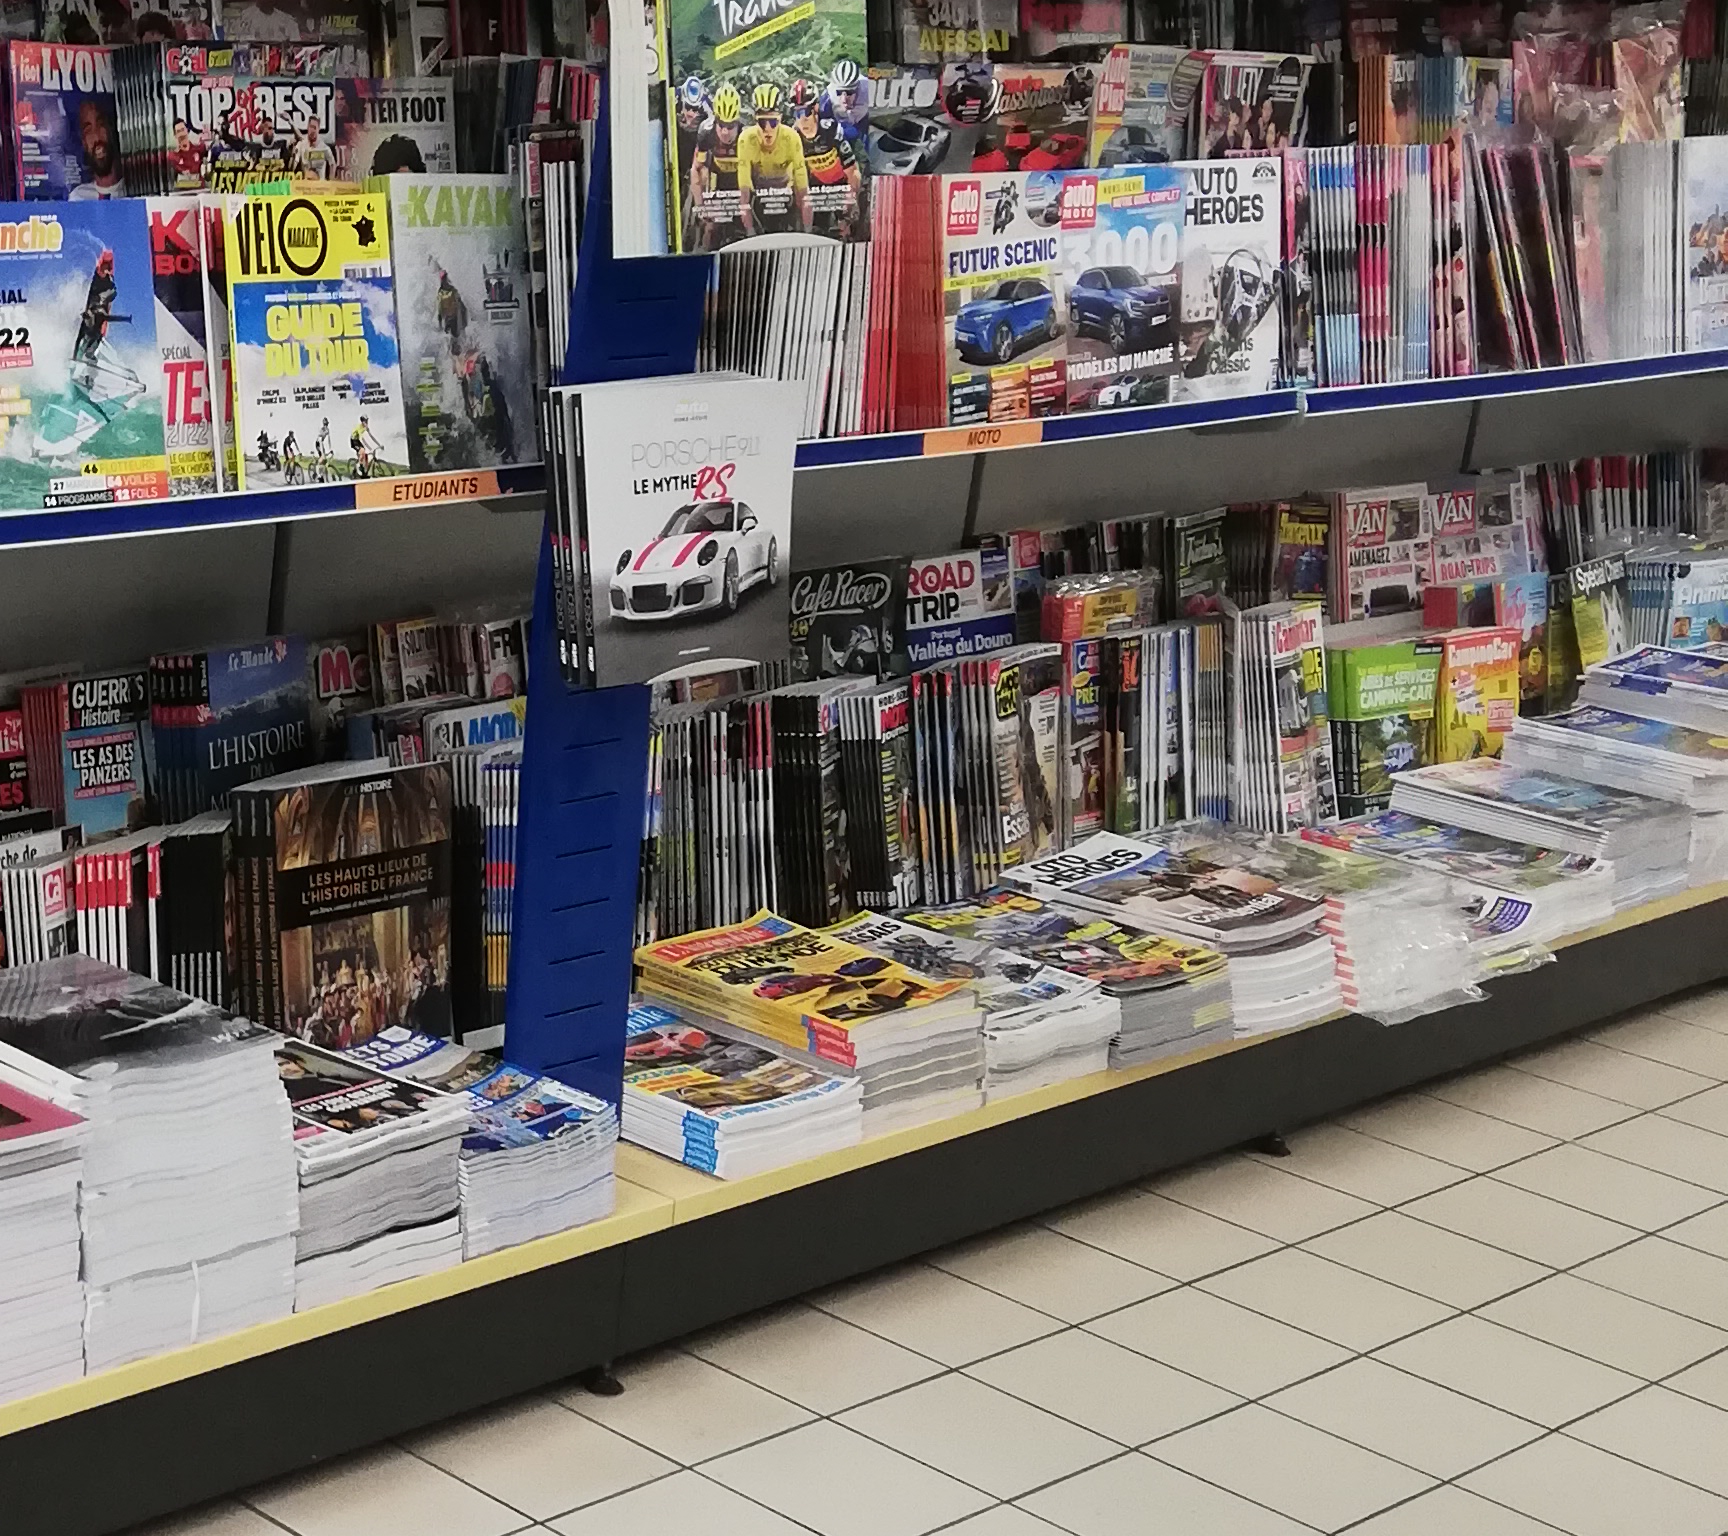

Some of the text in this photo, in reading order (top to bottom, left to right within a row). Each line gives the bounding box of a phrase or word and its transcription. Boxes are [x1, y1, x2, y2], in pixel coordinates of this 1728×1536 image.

[39, 45, 114, 92] LYON
[174, 81, 234, 134] TOP
[258, 80, 332, 133] BEST
[402, 95, 446, 122] FOOT
[1185, 166, 1238, 197] AUTO
[406, 181, 513, 228] KAYAK
[949, 212, 978, 225] MOTO
[1063, 206, 1094, 219] MOTO
[1184, 194, 1264, 226] HEROES
[949, 237, 1058, 275] FUTUR SCENIC
[1063, 224, 1178, 275] 3000
[265, 305, 364, 342] GUIDE
[265, 337, 370, 379] DU TOUR
[1068, 341, 1174, 383] MODÈLES DU MARCHÉ
[632, 435, 761, 470] PORSCHE 911
[967, 428, 1001, 446] MOTO
[83, 464, 99, 475] 46
[123, 472, 157, 488] VOILES
[633, 464, 736, 501] LE MYTHE RS
[44, 487, 158, 508] 14 PROGRAMMES 12 FOILS
[393, 478, 479, 502] ETUDIANTS
[1348, 500, 1387, 542] VAN
[1434, 493, 1474, 529] VAN
[907, 560, 975, 596] ROAD
[907, 595, 959, 624] TRIP
[241, 648, 273, 670] Monde
[909, 631, 1013, 662] Vallée du Douro
[81, 708, 120, 727] Histoire
[73, 742, 134, 768] LES AS DES
[209, 719, 306, 770] L'HISTOIRE
[81, 765, 131, 787] PANZERS
[23, 847, 37, 861] de
[309, 853, 427, 888] LES HAUTS LIEUX DE
[1054, 847, 1143, 888] HEROES
[301, 866, 434, 906] L'HISTOIRE DE FRANCE
